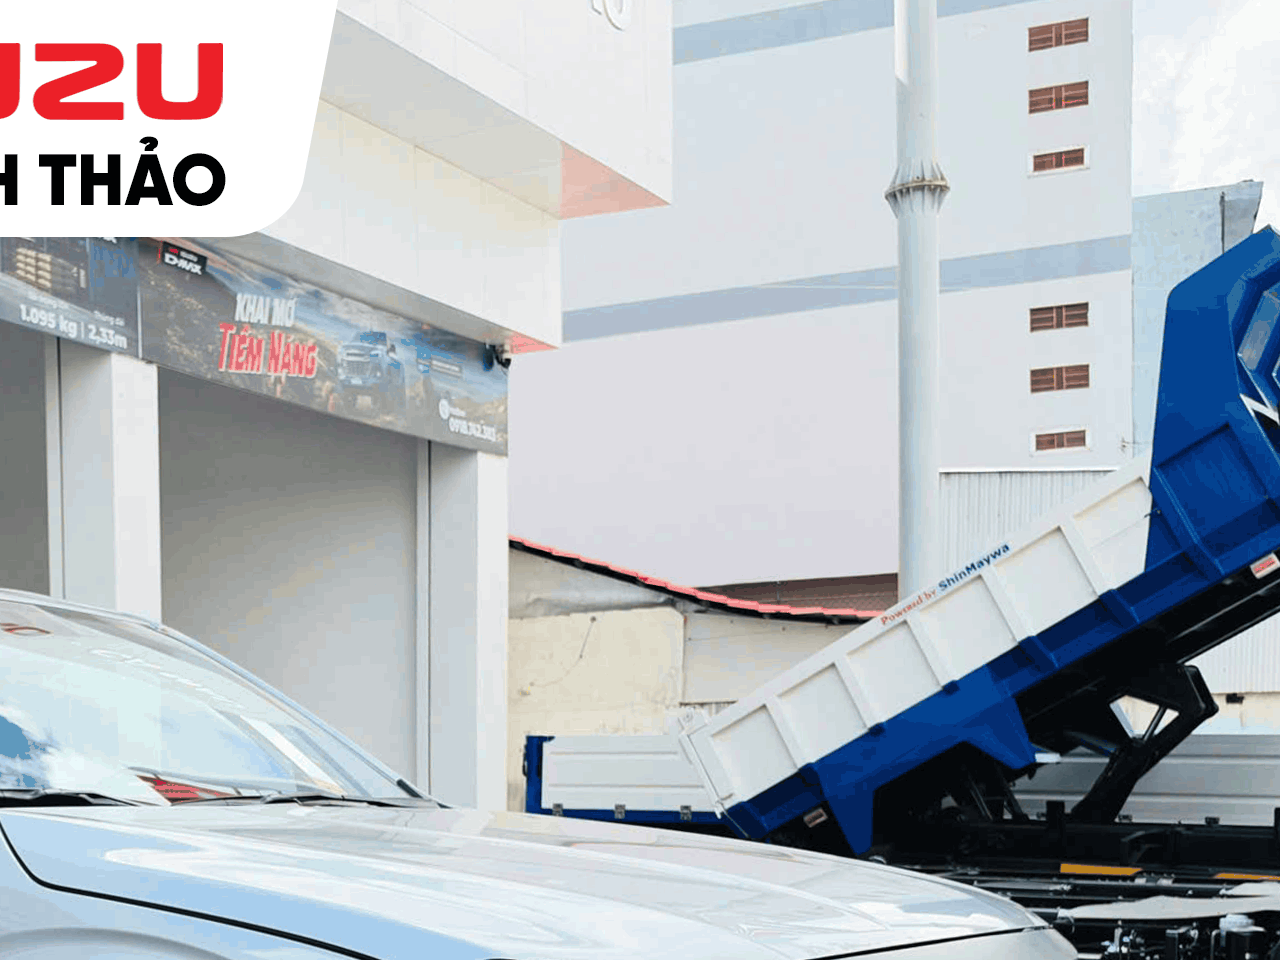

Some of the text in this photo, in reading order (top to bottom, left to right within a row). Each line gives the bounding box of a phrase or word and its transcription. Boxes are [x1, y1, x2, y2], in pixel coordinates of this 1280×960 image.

[20, 303, 56, 330] 1.095
[58, 313, 78, 339] kg
[880, 595, 923, 626] Powered
[938, 543, 1010, 591] ShinMaywa
